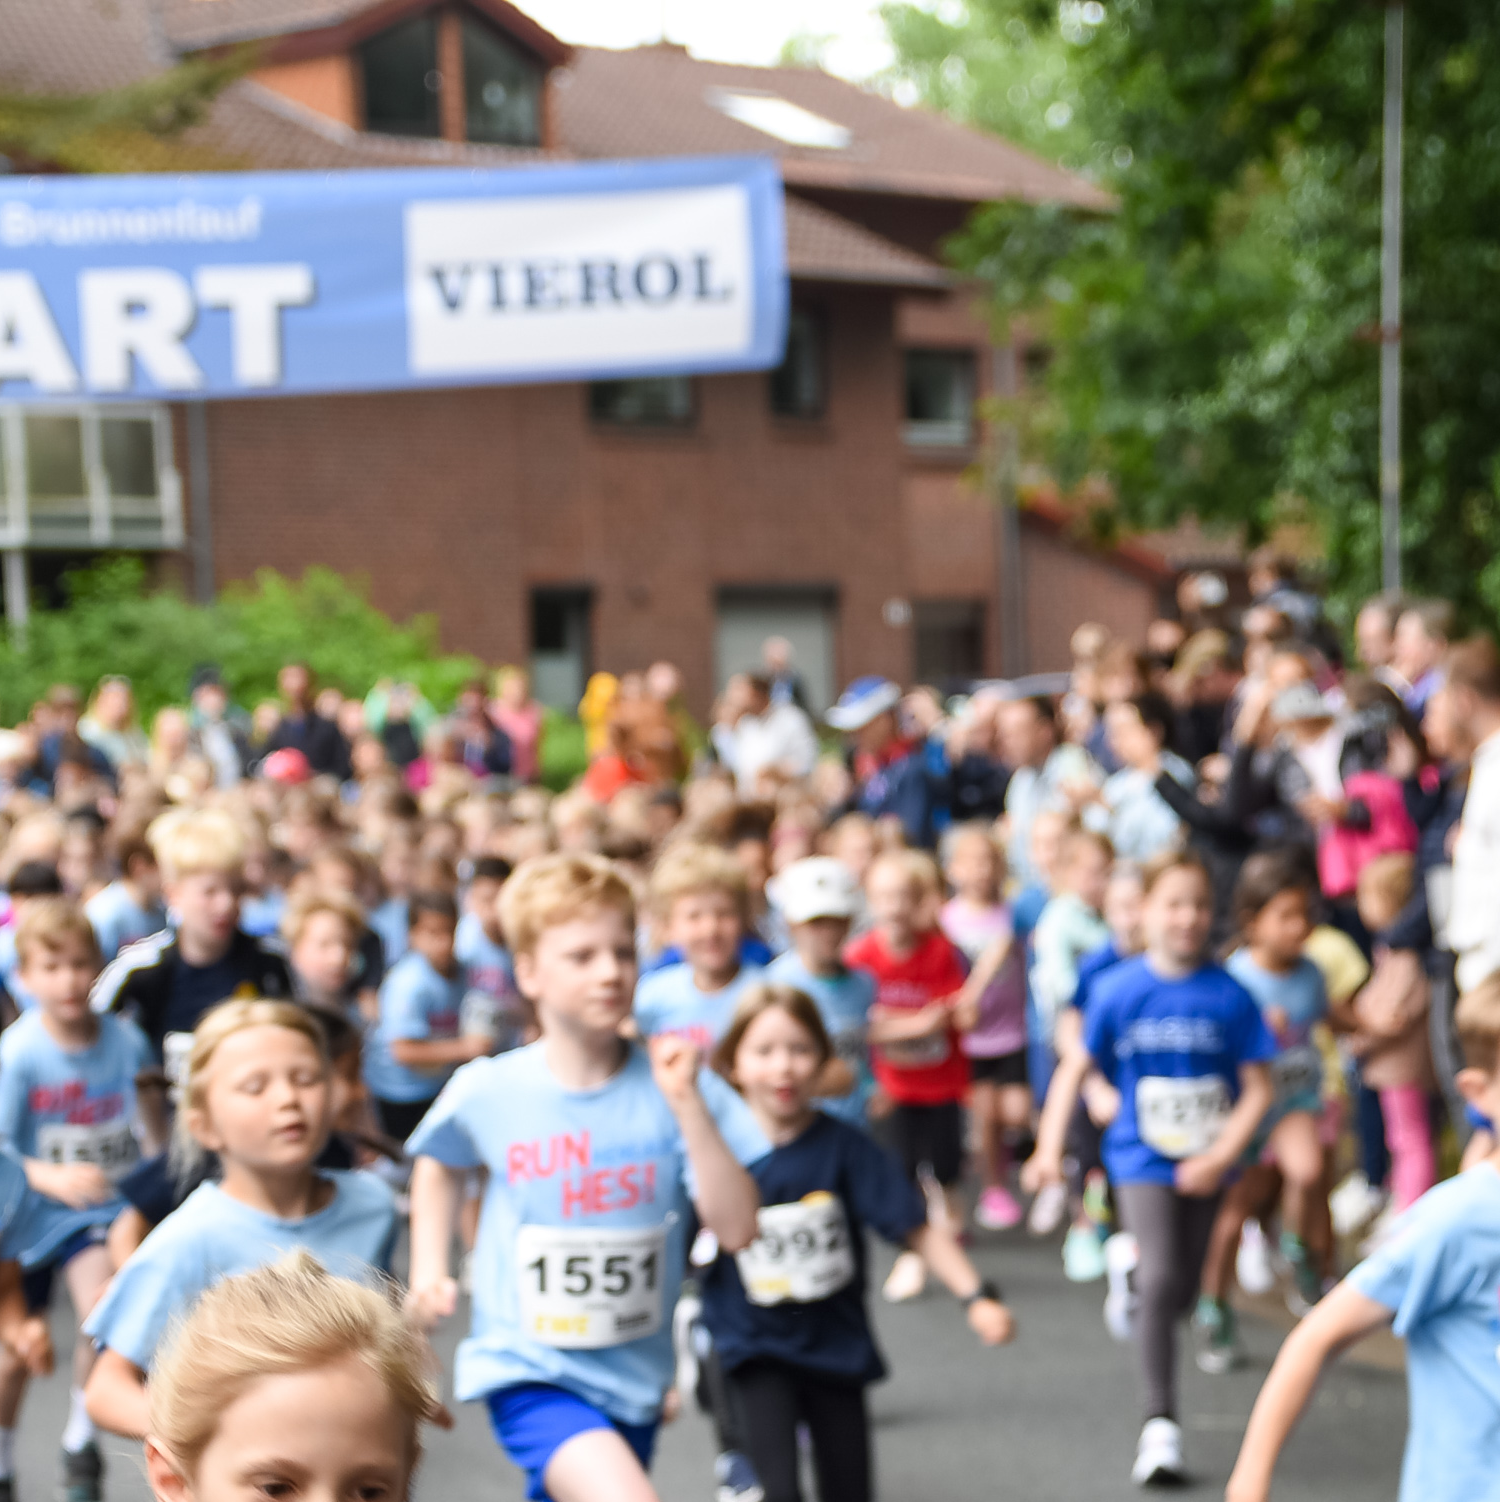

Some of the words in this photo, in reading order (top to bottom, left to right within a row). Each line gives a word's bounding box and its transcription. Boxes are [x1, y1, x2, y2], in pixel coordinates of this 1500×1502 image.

[428, 252, 733, 318] VIEROL
[507, 1131, 590, 1185] RUN
[562, 1162, 656, 1218] HES!
[527, 1251, 658, 1296] 1551
